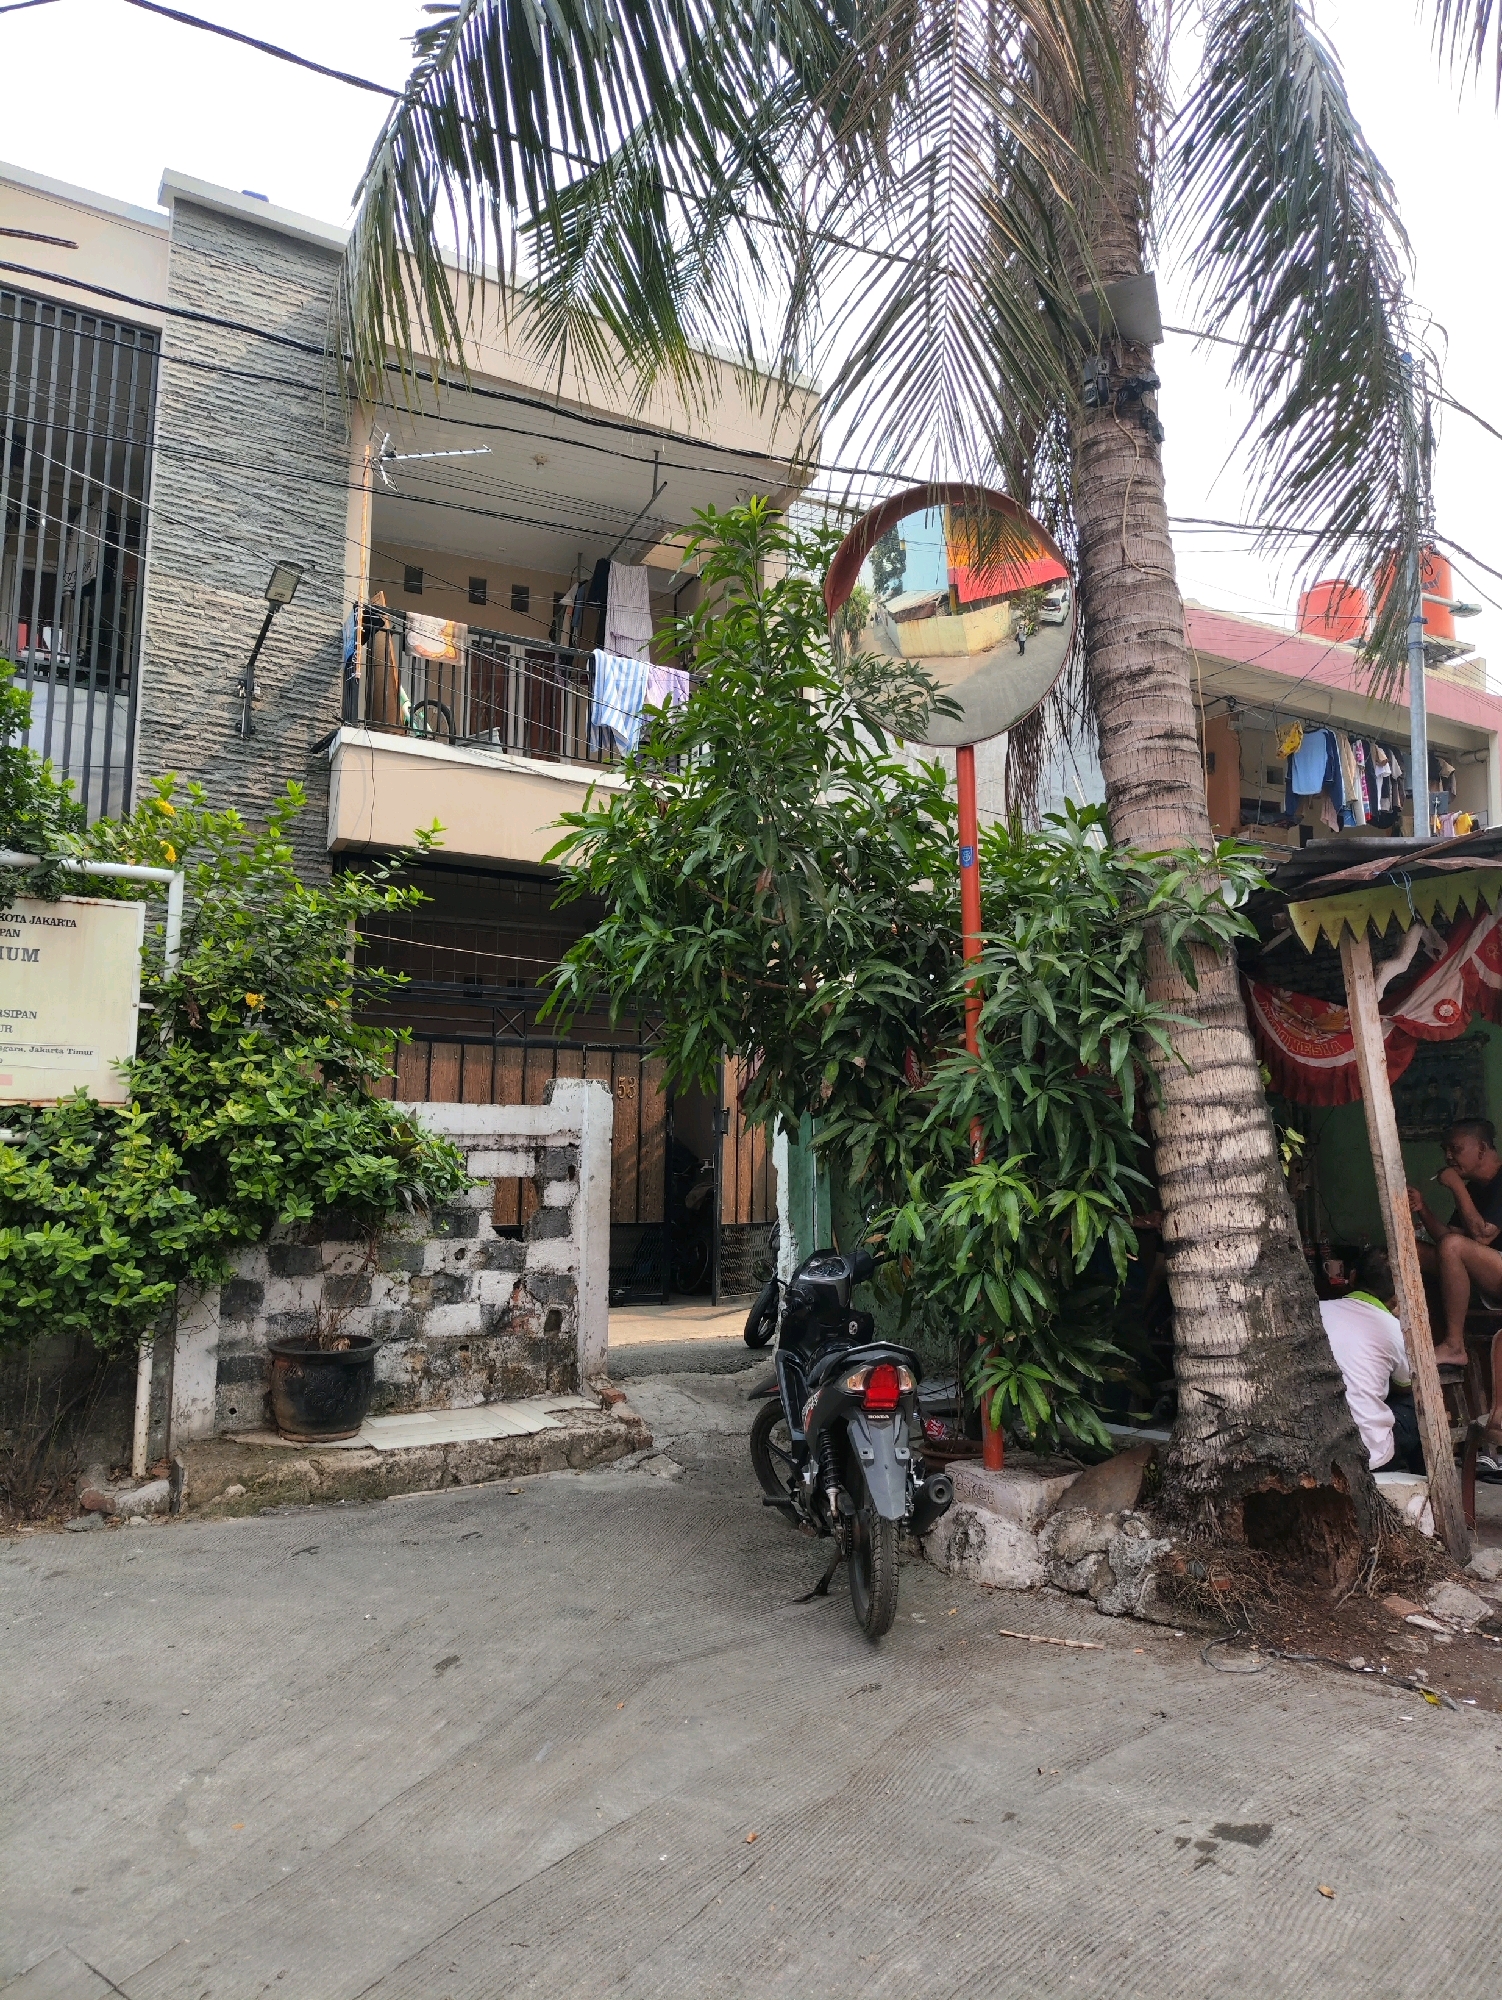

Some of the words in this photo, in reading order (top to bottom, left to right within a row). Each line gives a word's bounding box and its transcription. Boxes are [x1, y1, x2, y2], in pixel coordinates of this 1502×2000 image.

[29, 915, 77, 927] JAKARTA
[29, 1046, 64, 1055] Jakarta
[67, 1048, 94, 1056] Timur
[617, 1076, 637, 1100] 53
